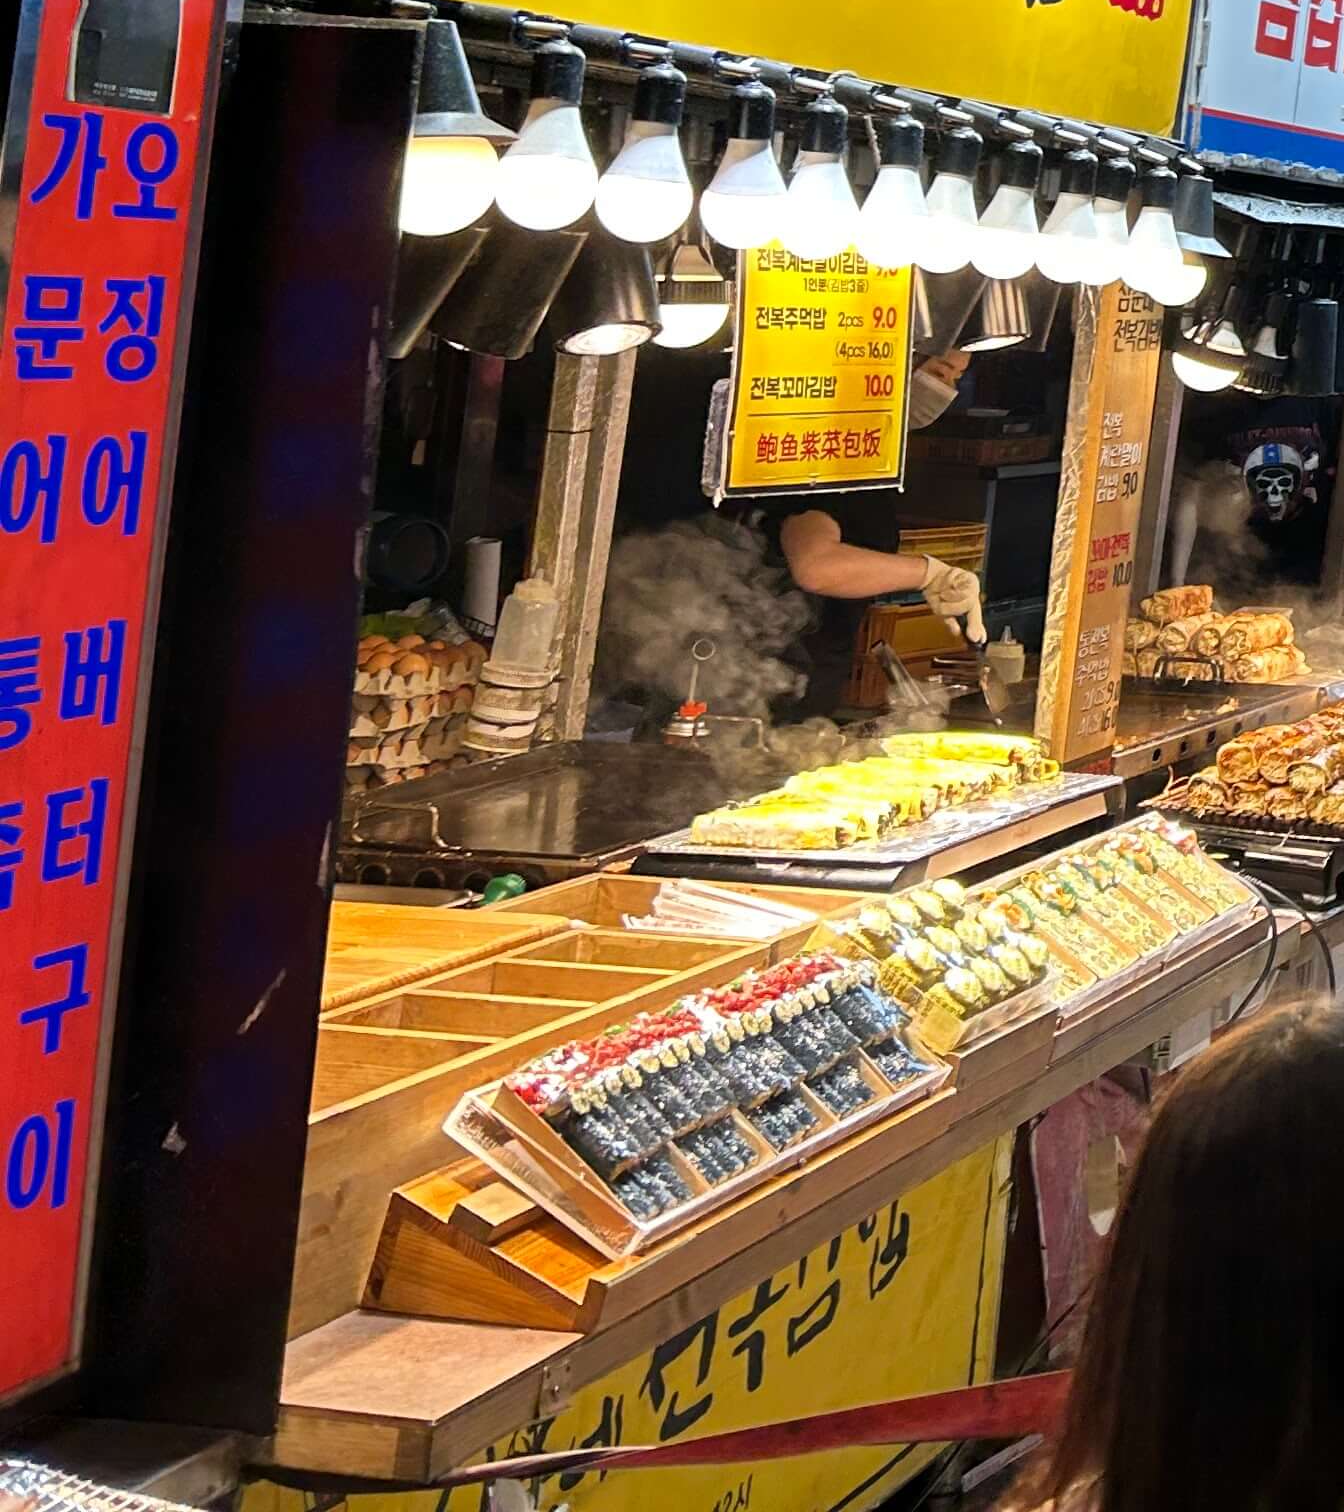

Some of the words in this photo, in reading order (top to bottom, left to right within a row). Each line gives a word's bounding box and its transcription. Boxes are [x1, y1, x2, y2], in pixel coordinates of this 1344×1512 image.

[756, 306, 827, 330] 전복주먹밥
[750, 376, 837, 400] 전복꼬마김밥
[864, 375, 894, 397] 10.0
[755, 427, 882, 463] 鲍鱼紫菜包饭
